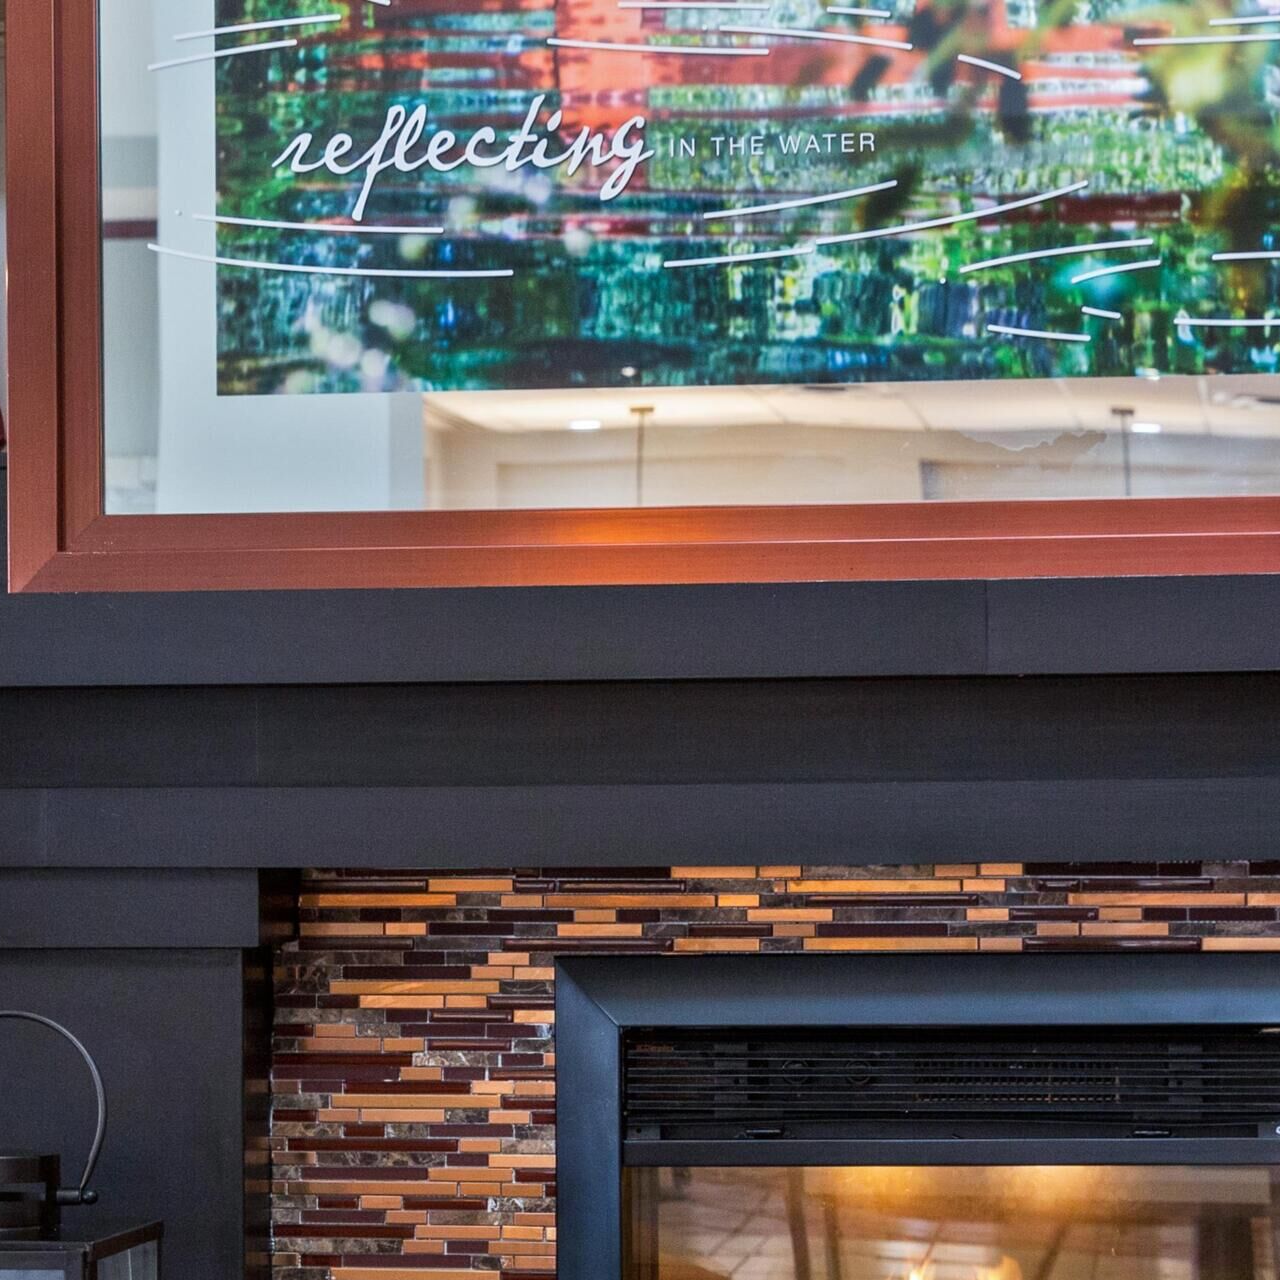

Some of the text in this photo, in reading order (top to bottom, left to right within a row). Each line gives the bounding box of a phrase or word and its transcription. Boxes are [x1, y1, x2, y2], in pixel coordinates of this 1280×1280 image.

[271, 93, 876, 222] reflecting IN THE WATER
